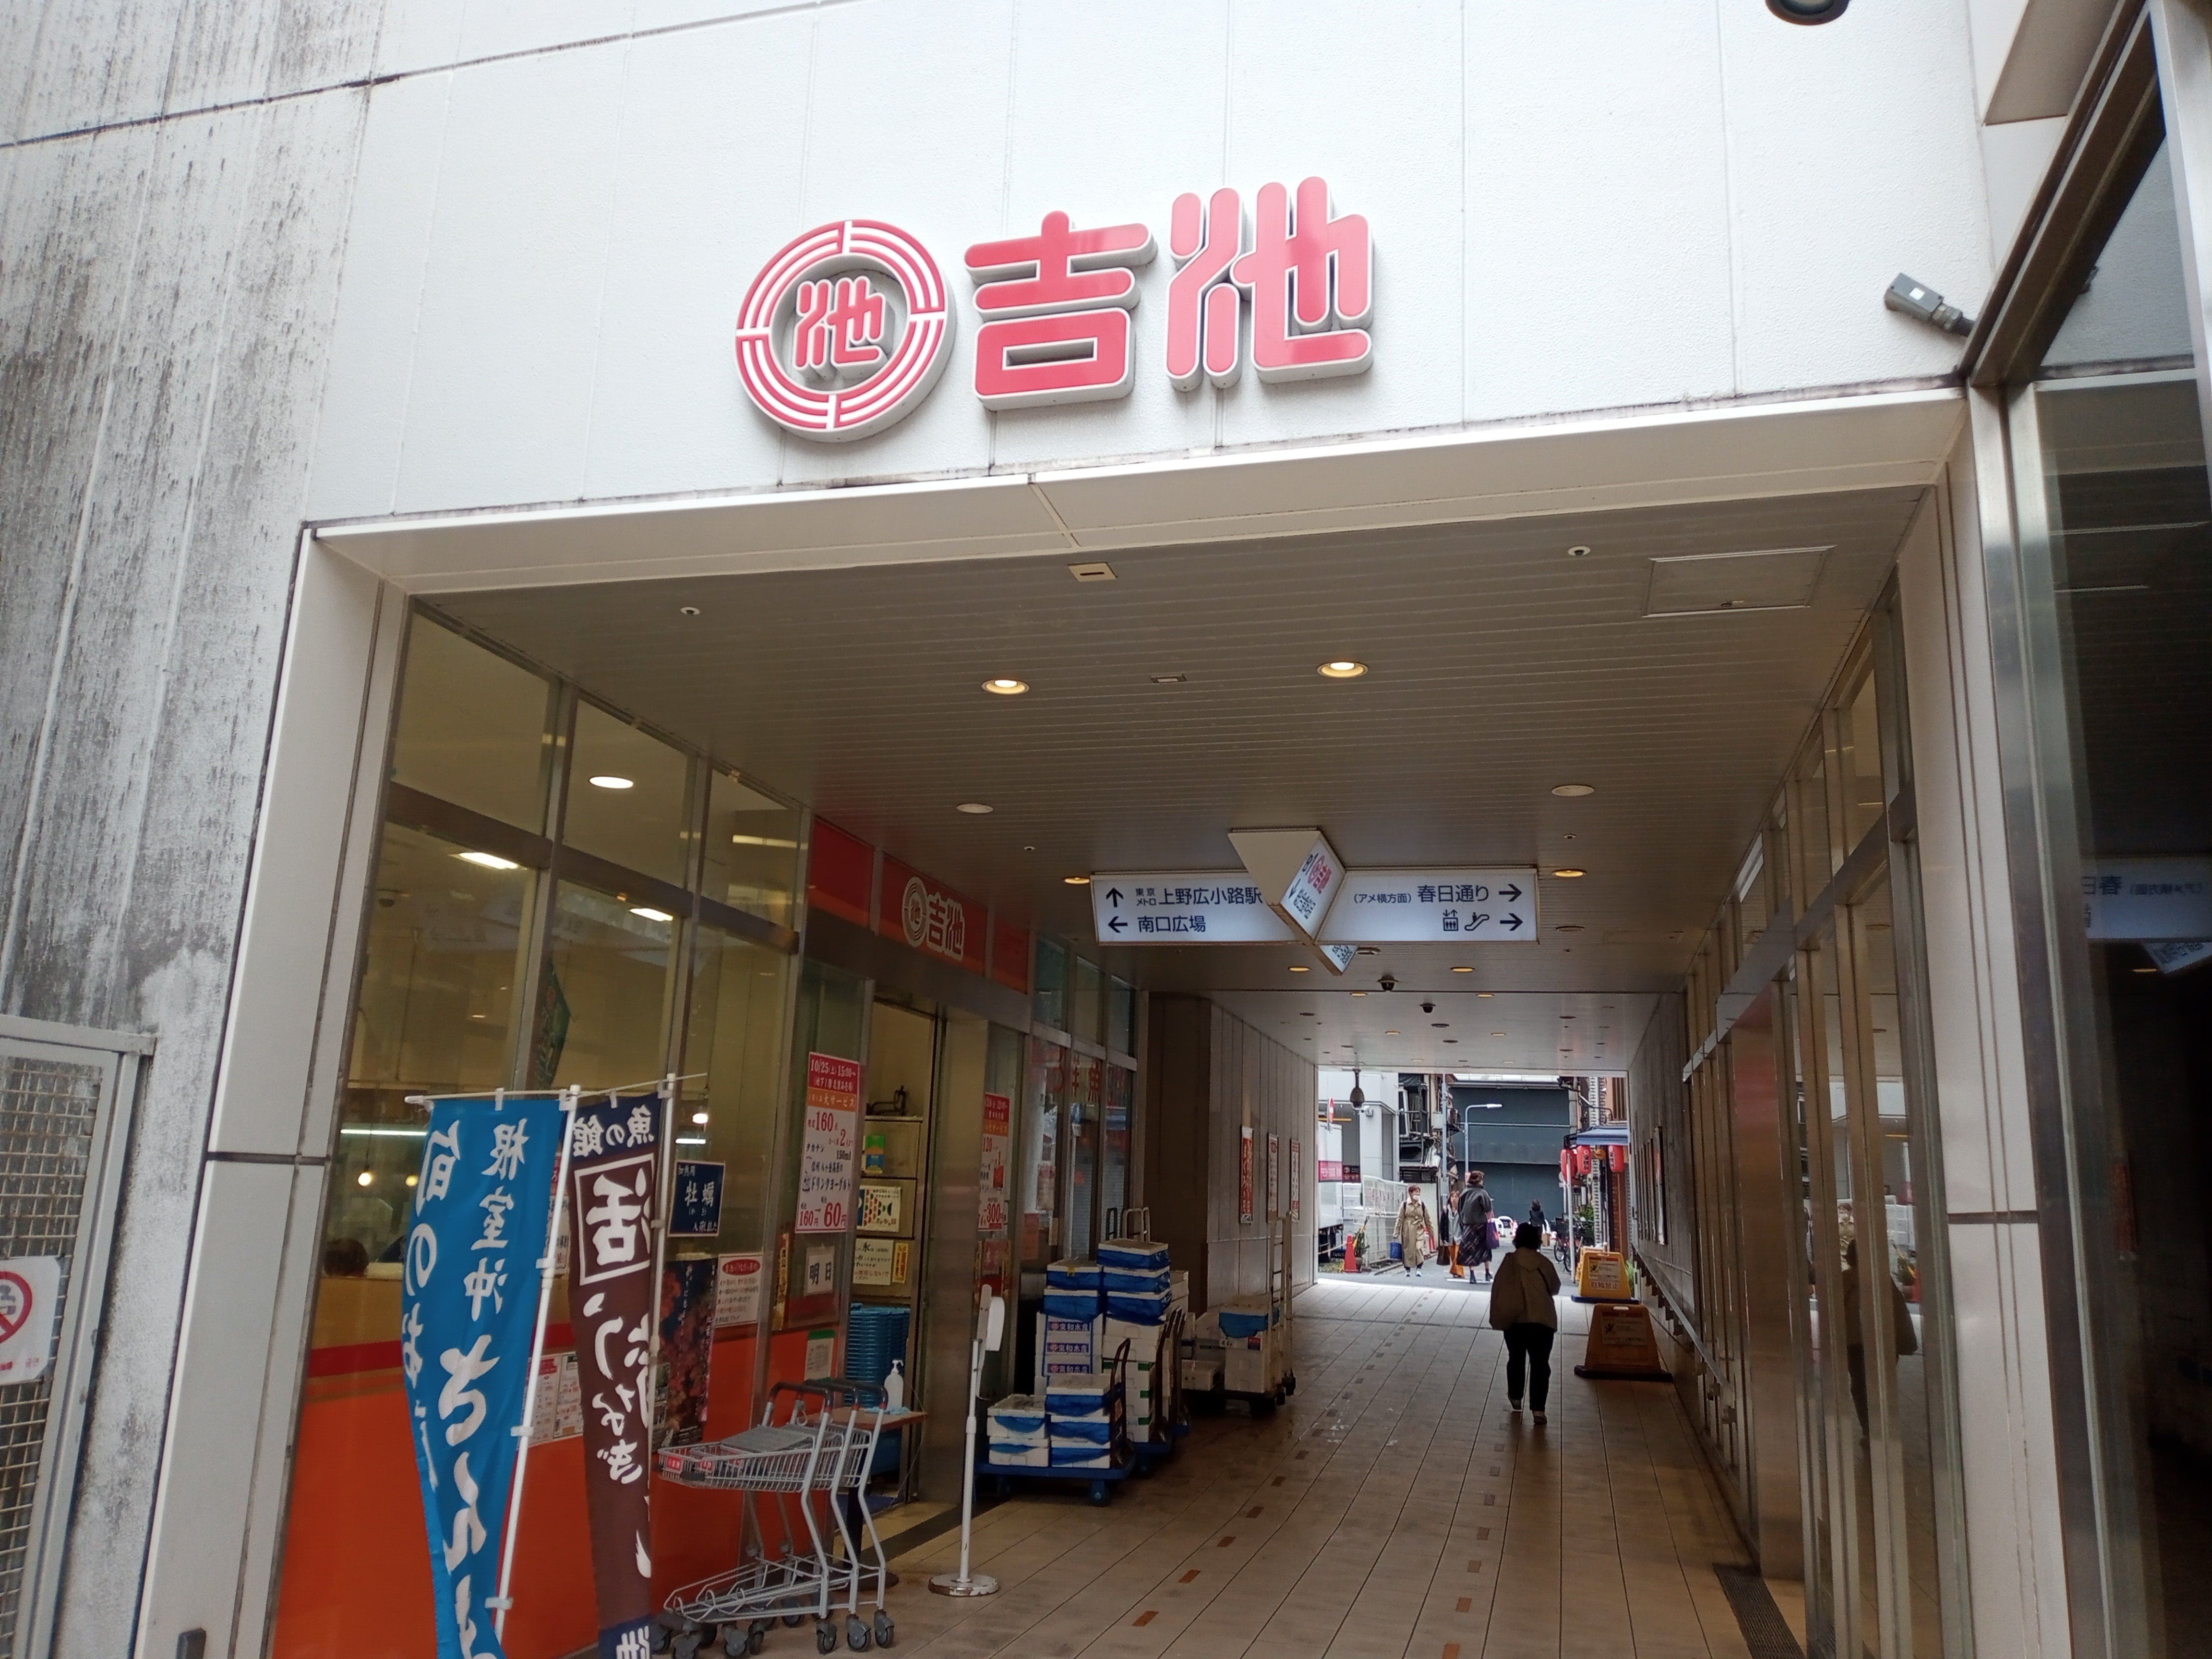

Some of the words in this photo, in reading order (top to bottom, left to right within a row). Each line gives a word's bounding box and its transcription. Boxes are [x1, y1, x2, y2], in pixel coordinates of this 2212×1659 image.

[963, 176, 1374, 403] 吉池
[1136, 888, 1155, 897] 東京
[1159, 887, 1263, 905] 上野広小路駅
[1353, 893, 1412, 904] (アメ横方面)
[1417, 885, 1490, 903] 春日通り
[1136, 898, 1156, 906] メトロ
[928, 897, 963, 956] 吉池
[1137, 915, 1207, 933] 南口広場
